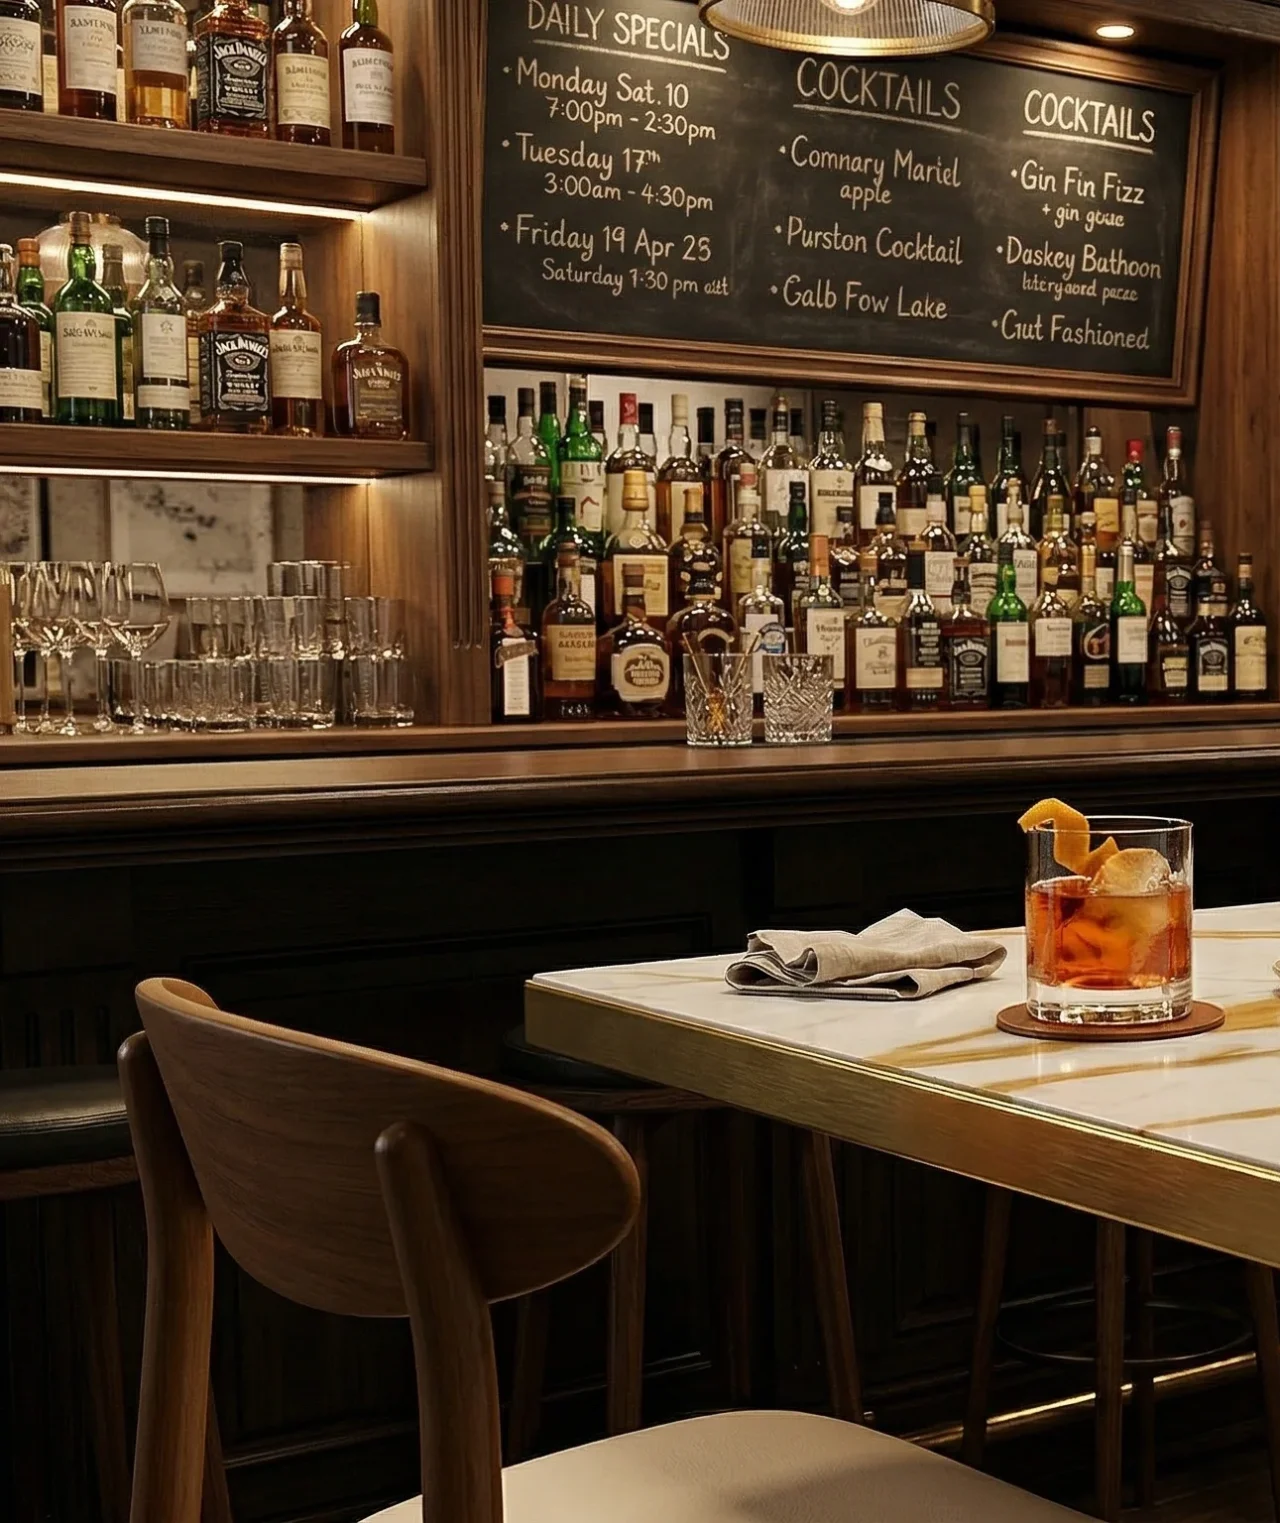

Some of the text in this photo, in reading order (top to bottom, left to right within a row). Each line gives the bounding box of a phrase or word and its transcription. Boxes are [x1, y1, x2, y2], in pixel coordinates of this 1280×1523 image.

[528, 0, 730, 61] DAILY SPECIALS
[517, 56, 689, 109] Monday Sat. 10
[796, 57, 961, 119] COCKTAILS
[545, 96, 623, 134] 7:00pm
[644, 110, 716, 146] 2:30pm
[1024, 89, 1155, 143] COCKTAILS
[515, 131, 613, 181] Tuesday
[544, 172, 621, 201] 3:00am
[641, 182, 714, 218] 4:30pm
[839, 182, 893, 212] apple
[1020, 159, 1145, 205] Gin Fin Fizz
[516, 213, 594, 262] Friday
[602, 225, 626, 254] 19
[634, 227, 675, 266] Apr
[1054, 202, 1080, 229] gin
[787, 215, 963, 266] Purston Cocktail
[1081, 243, 1162, 280] Bathoon
[542, 257, 623, 297] Saturday
[673, 279, 699, 300] pm
[845, 281, 890, 313] Fow
[897, 285, 948, 319] Lake
[1051, 314, 1150, 350] Fashioned
